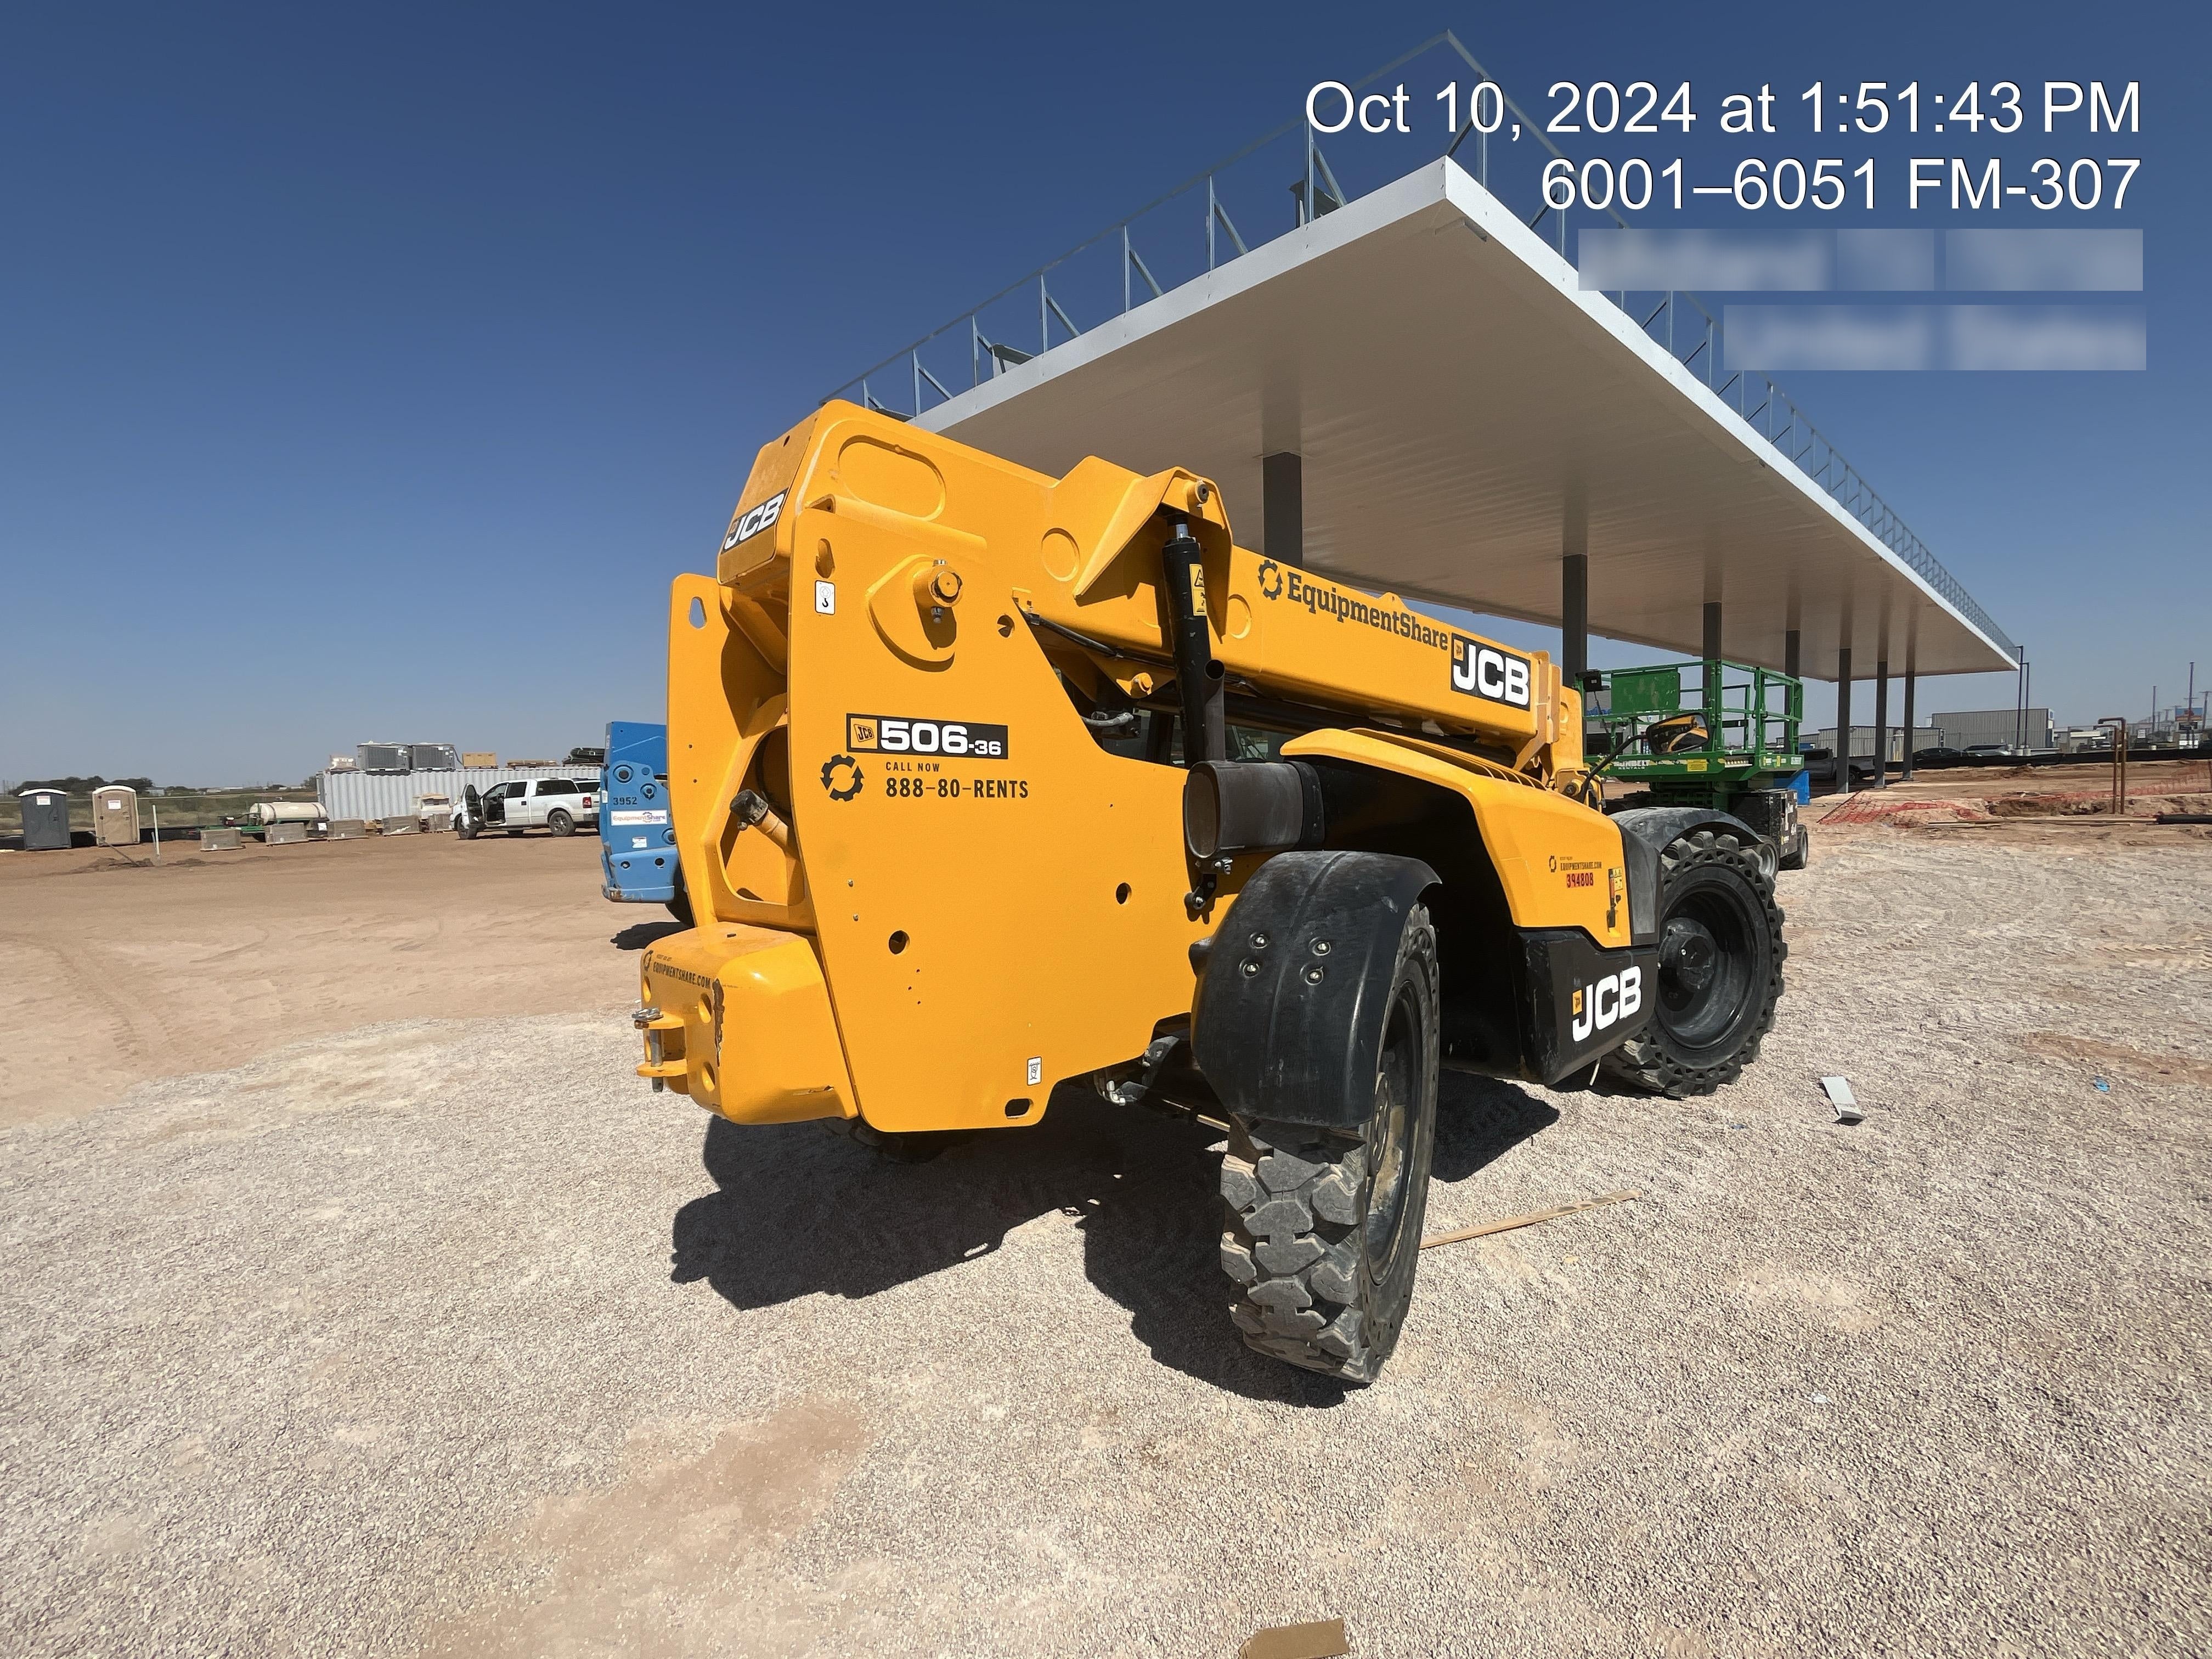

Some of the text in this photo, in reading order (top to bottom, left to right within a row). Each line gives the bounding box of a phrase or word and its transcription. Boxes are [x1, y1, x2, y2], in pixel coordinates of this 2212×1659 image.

[724, 493, 785, 550] JCB
[1287, 571, 1449, 651] EquipmentShare
[1453, 644, 1530, 706] JCB
[857, 725, 874, 740] JCB
[880, 719, 1002, 756] 506-36
[885, 761, 940, 772] CALL NOW
[613, 796, 638, 806] 3952
[885, 777, 1029, 799] 888-80-RENTS
[1566, 872, 1594, 889] 394808
[652, 961, 712, 989] EQUIPMENTSHARE.COM
[1572, 966, 1642, 1042] JCB
